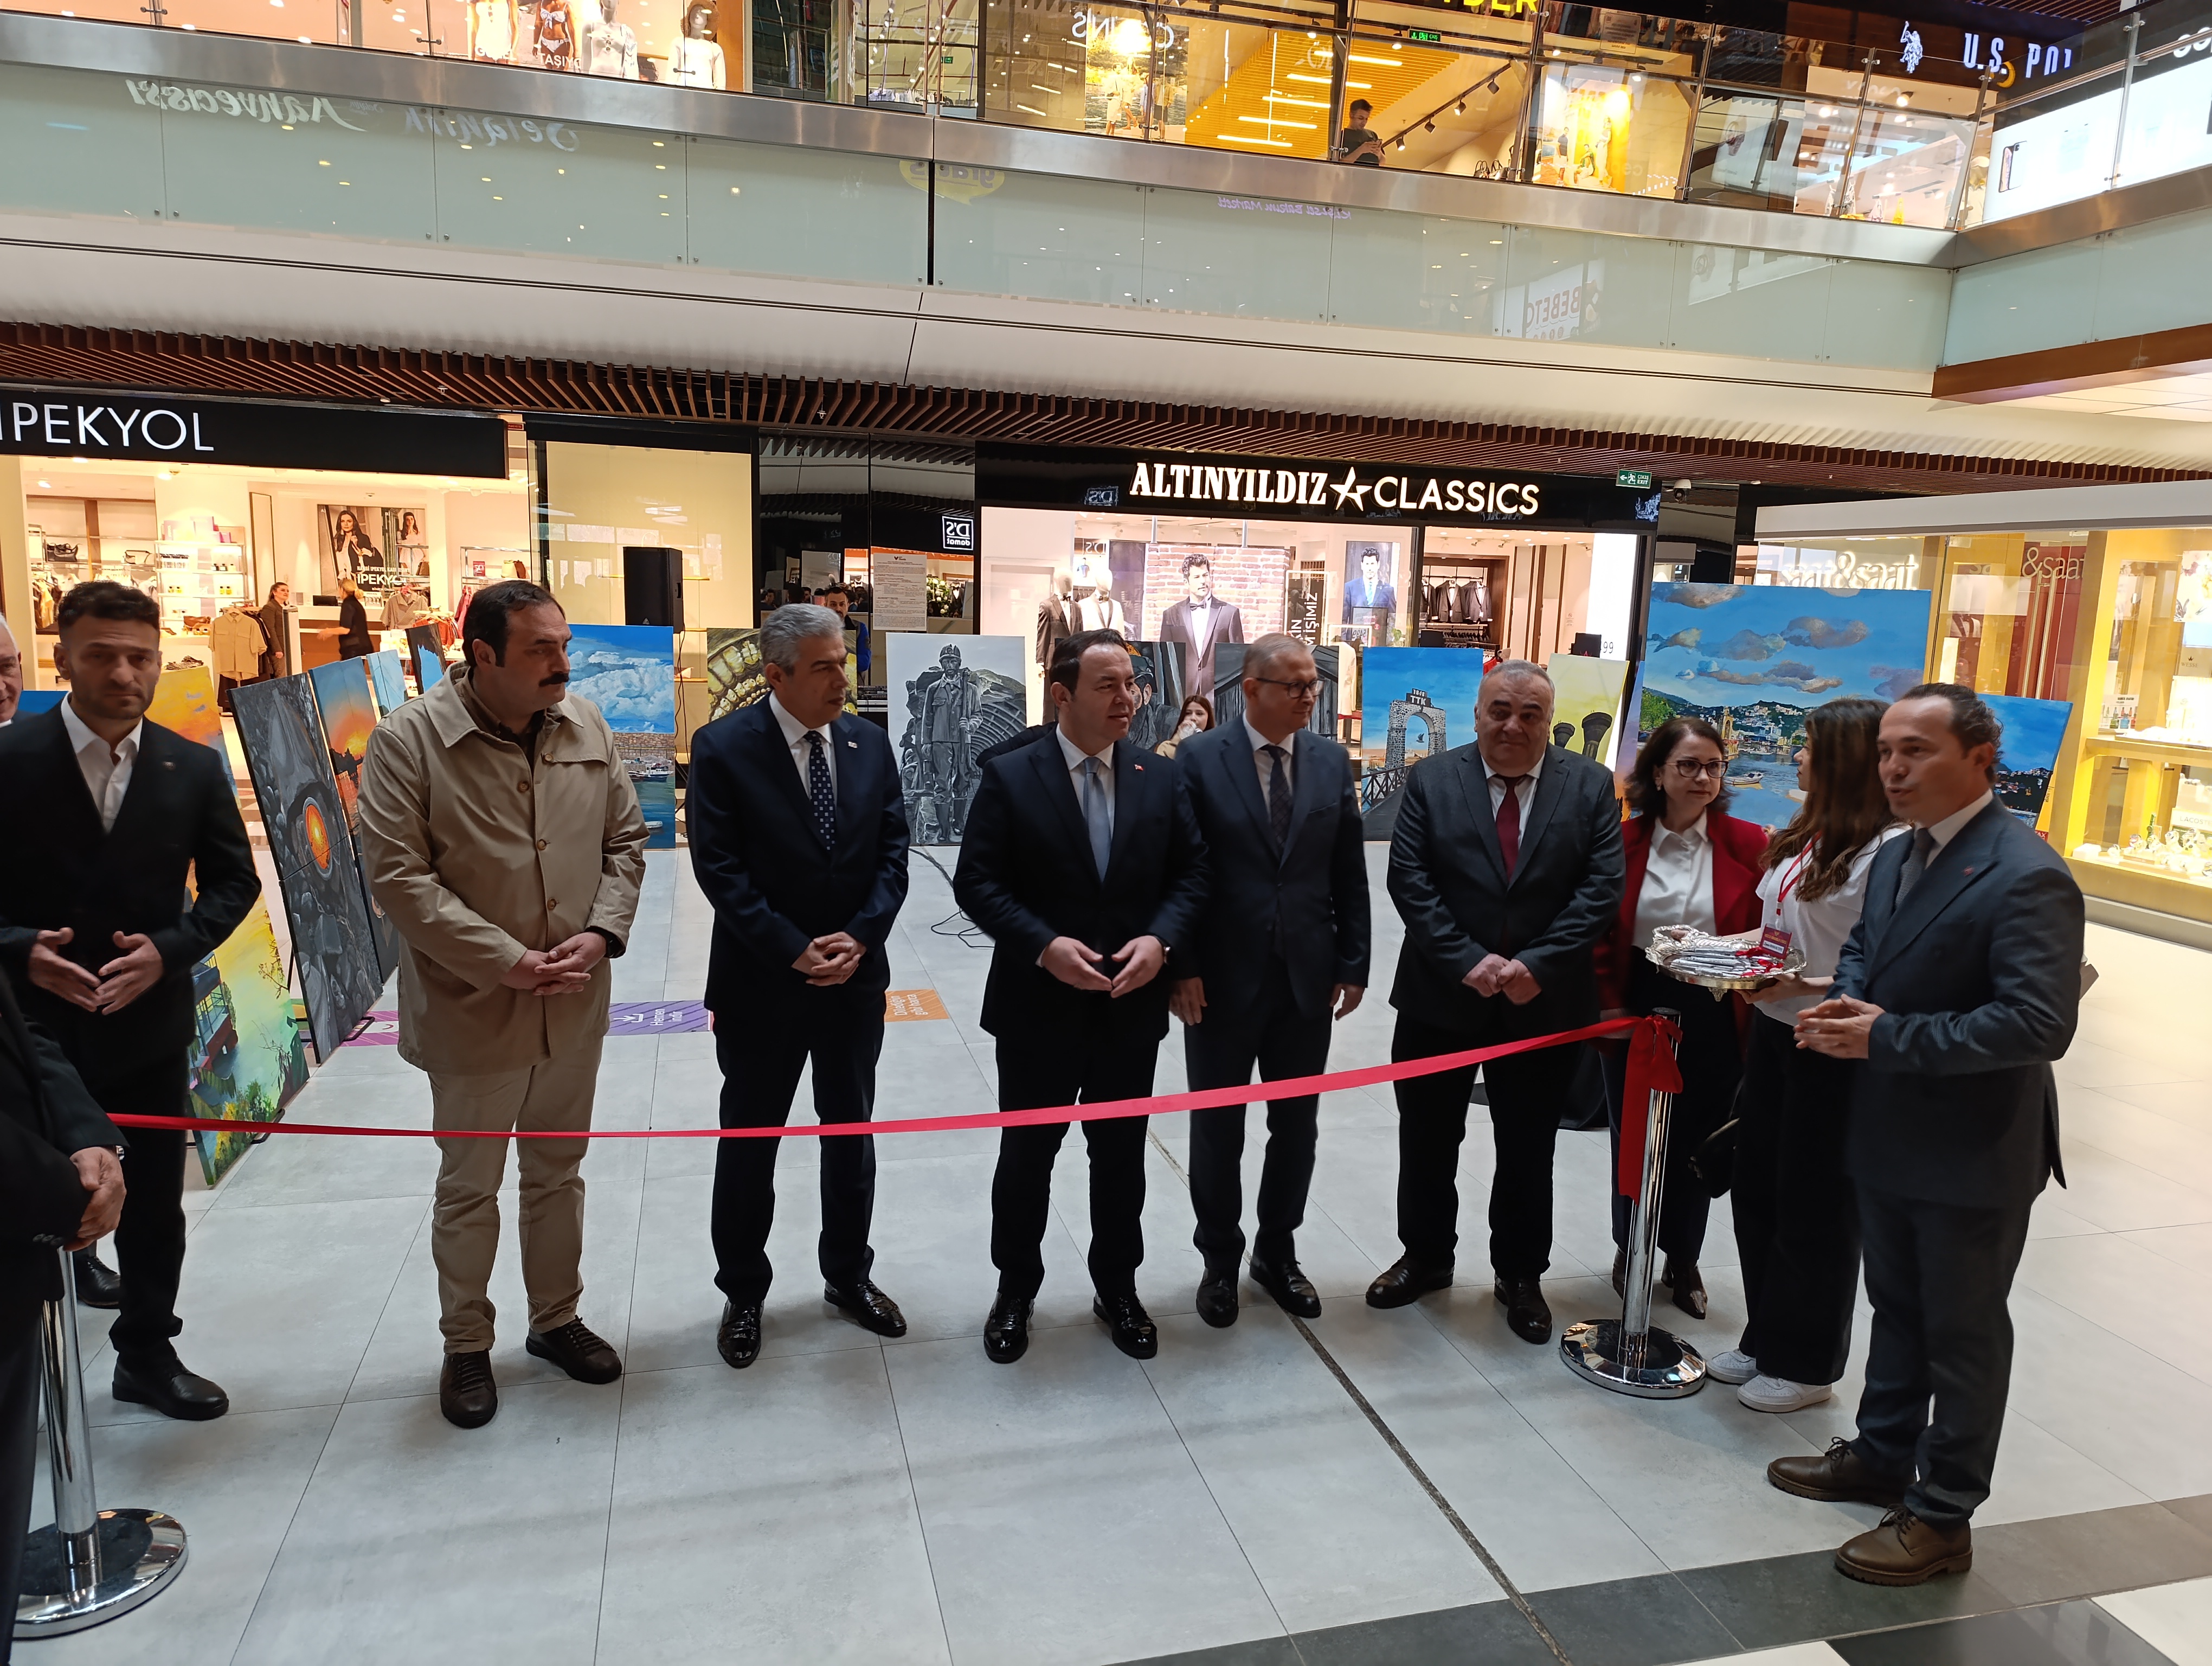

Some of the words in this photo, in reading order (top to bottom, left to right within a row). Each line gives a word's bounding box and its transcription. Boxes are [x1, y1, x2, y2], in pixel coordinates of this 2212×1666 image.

[1963, 33, 2007, 74] U.S.
[1129, 462, 1328, 505] ALTINYILDIZ
[1373, 476, 1539, 515] CLASSICS
[1303, 592, 1320, 633] İŞİMİZ
[1410, 695, 1426, 706] TTK
[1413, 689, 1425, 697] 1848
[650, 1009, 665, 1026] Hemen
[668, 1011, 683, 1022] indir
